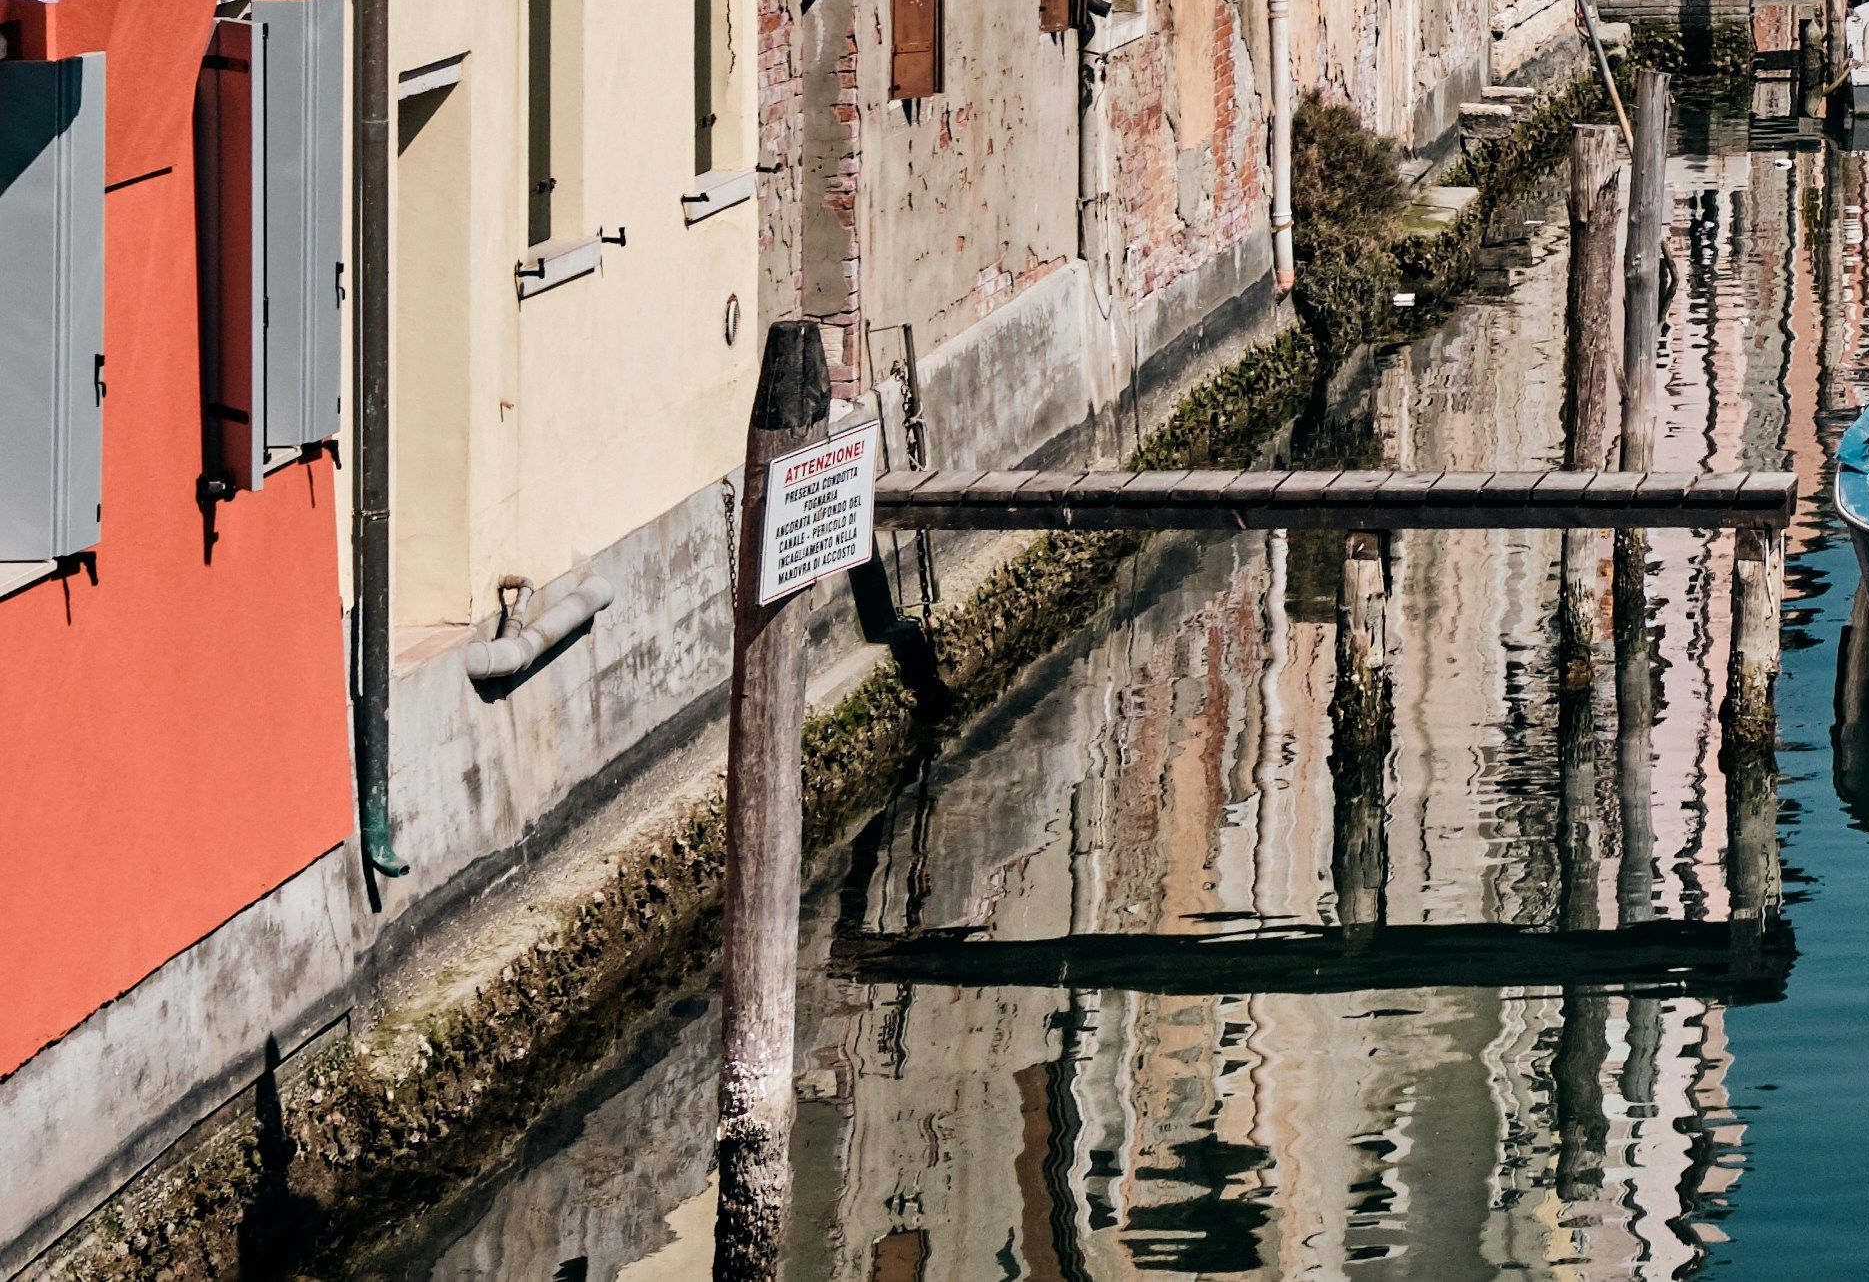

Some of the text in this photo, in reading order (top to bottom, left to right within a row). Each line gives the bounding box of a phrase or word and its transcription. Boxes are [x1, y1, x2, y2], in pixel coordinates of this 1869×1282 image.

[785, 440, 865, 484] ATTENZIONE!
[785, 466, 858, 505] PRESENZA CONDOTTA
[803, 489, 838, 513] FOGNARIA
[776, 515, 810, 539] ANCORATA
[823, 503, 847, 520] FONDO
[849, 495, 862, 510] DEL
[779, 533, 805, 553] CANALE
[812, 516, 847, 538] PERICOLO
[849, 512, 856, 525] DI
[778, 527, 857, 569] INCAGLIAMENTO NELLA
[778, 544, 856, 585] MANOVRA DI ACCOSTO
